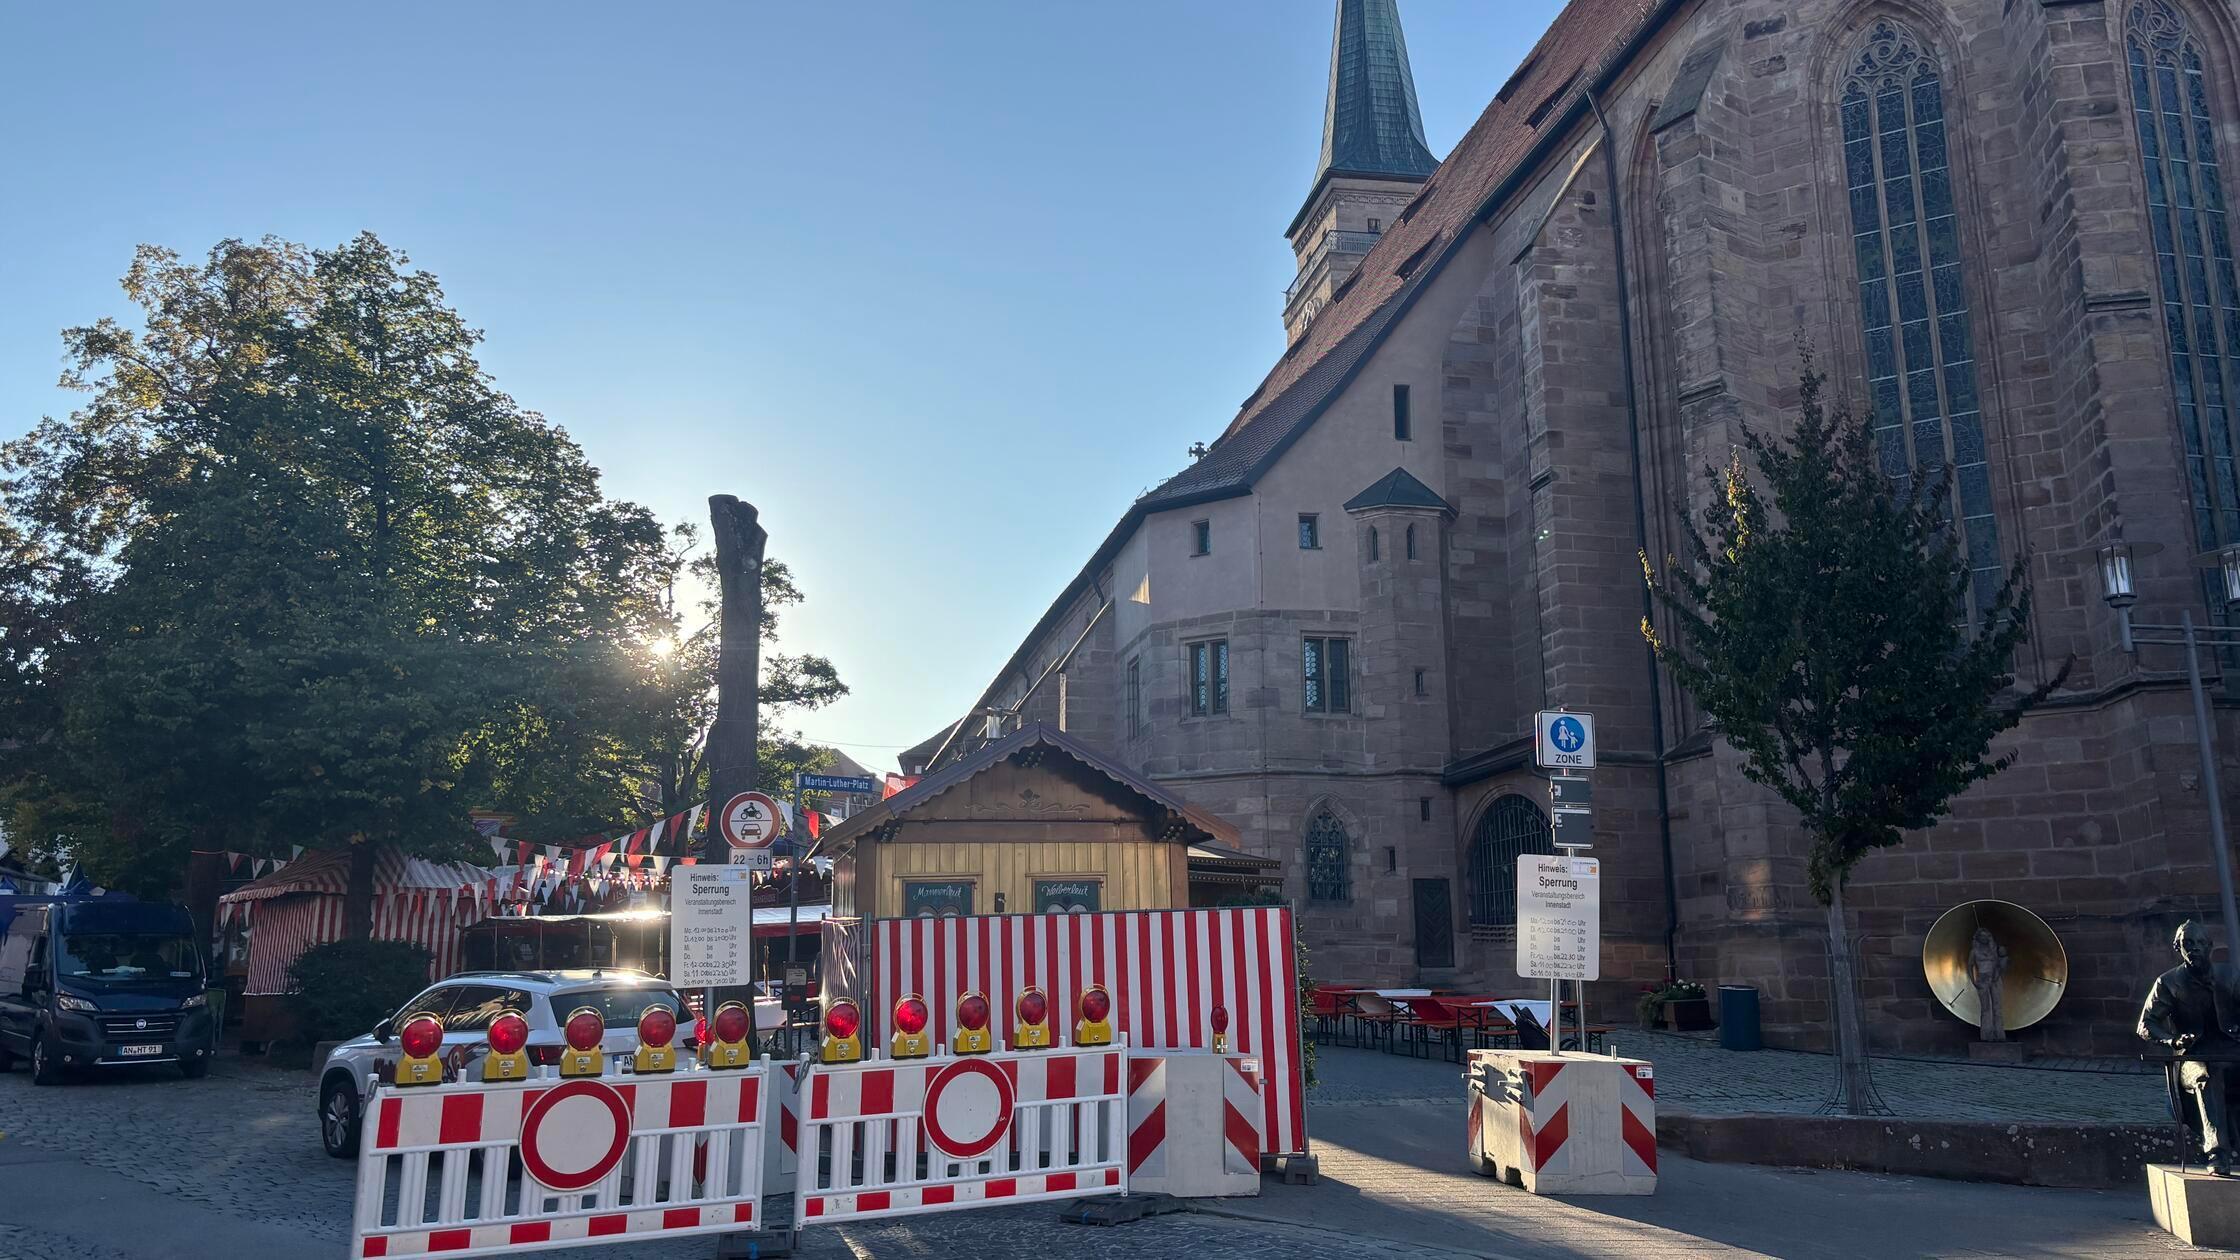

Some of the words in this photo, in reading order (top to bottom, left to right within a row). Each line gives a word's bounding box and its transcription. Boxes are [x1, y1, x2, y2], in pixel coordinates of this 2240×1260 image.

[1555, 754, 1582, 764] ZONE
[804, 776, 869, 789] Martin-Luther-Platz
[733, 854, 746, 865] 22
[757, 855, 768, 865] 6h
[1538, 864, 1568, 873] Hinweis:
[690, 873, 719, 882] Hinweis:
[1539, 876, 1578, 890] Sperrung
[692, 884, 730, 896] Sperrung
[1531, 890, 1585, 900] Veranstaltungsbereich
[685, 898, 737, 907] Veranstaltungsbereich
